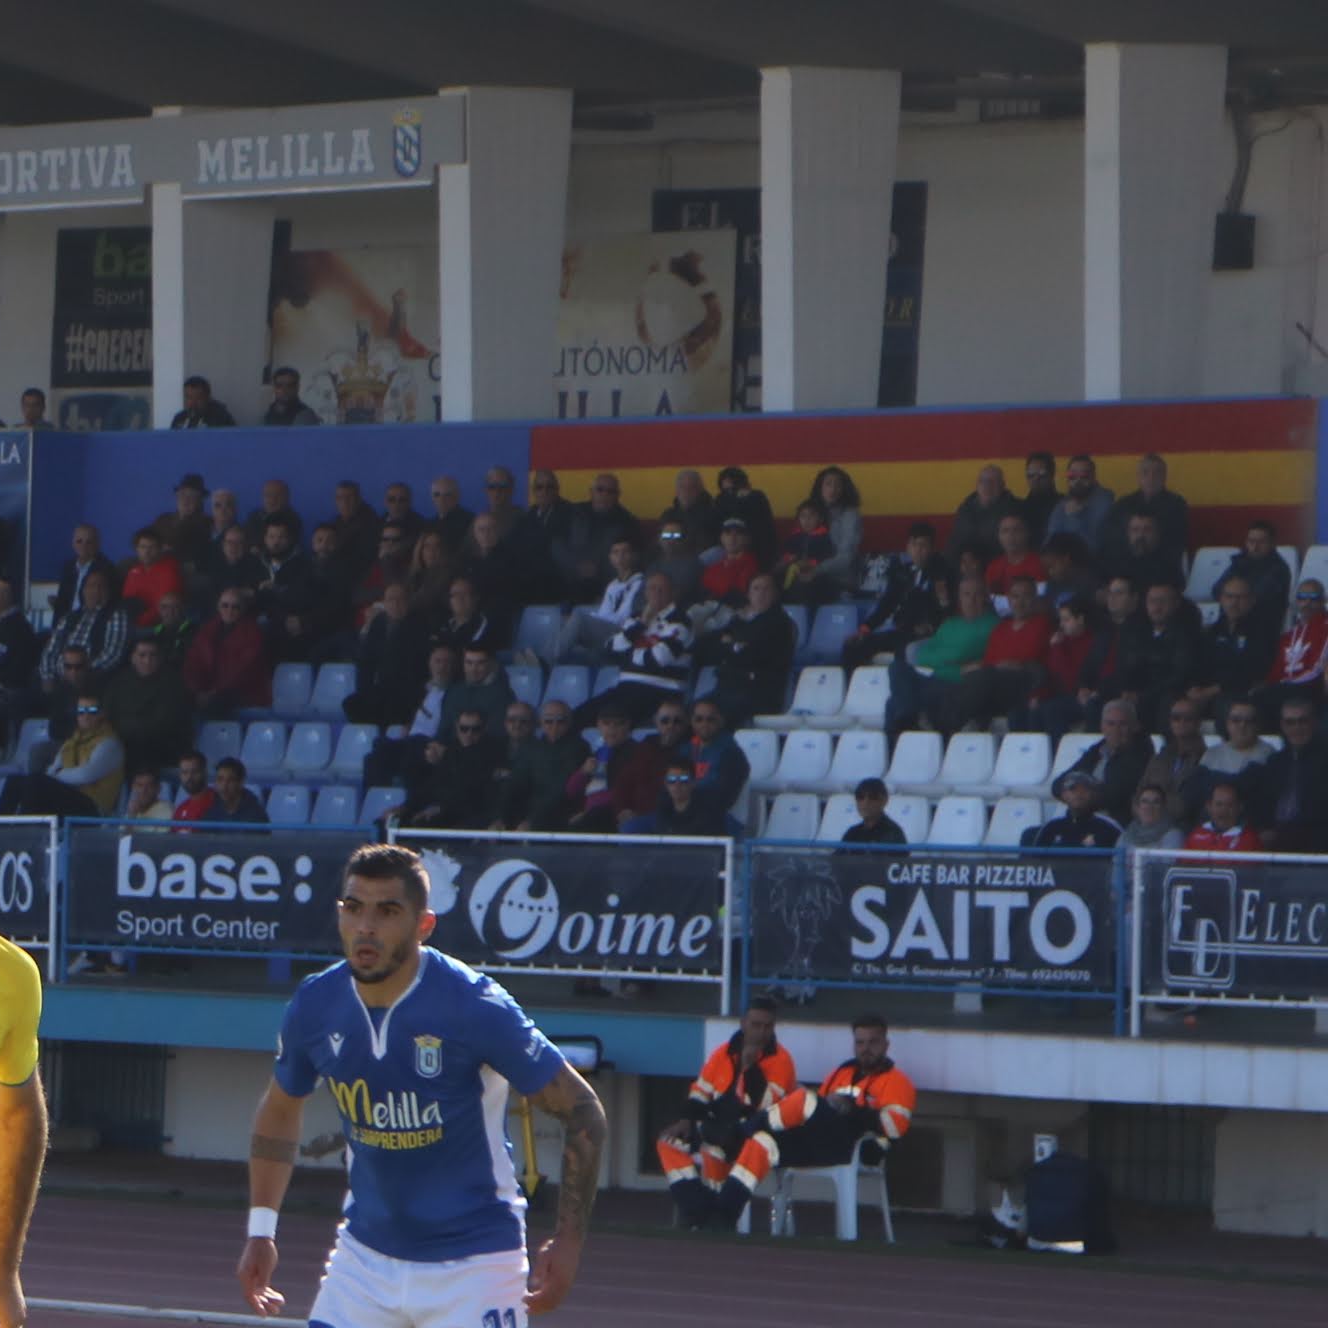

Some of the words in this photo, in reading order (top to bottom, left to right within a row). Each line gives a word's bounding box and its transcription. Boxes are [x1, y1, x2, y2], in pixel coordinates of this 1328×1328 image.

[197, 128, 375, 184] MELILLA
[887, 863, 931, 884] CAFE
[936, 865, 969, 885] BAR
[975, 866, 1055, 887] PIZZERIA
[117, 910, 184, 940] Sport
[192, 913, 280, 940] Center
[850, 885, 1092, 965] SAITO
[328, 1076, 443, 1129] Melilla
